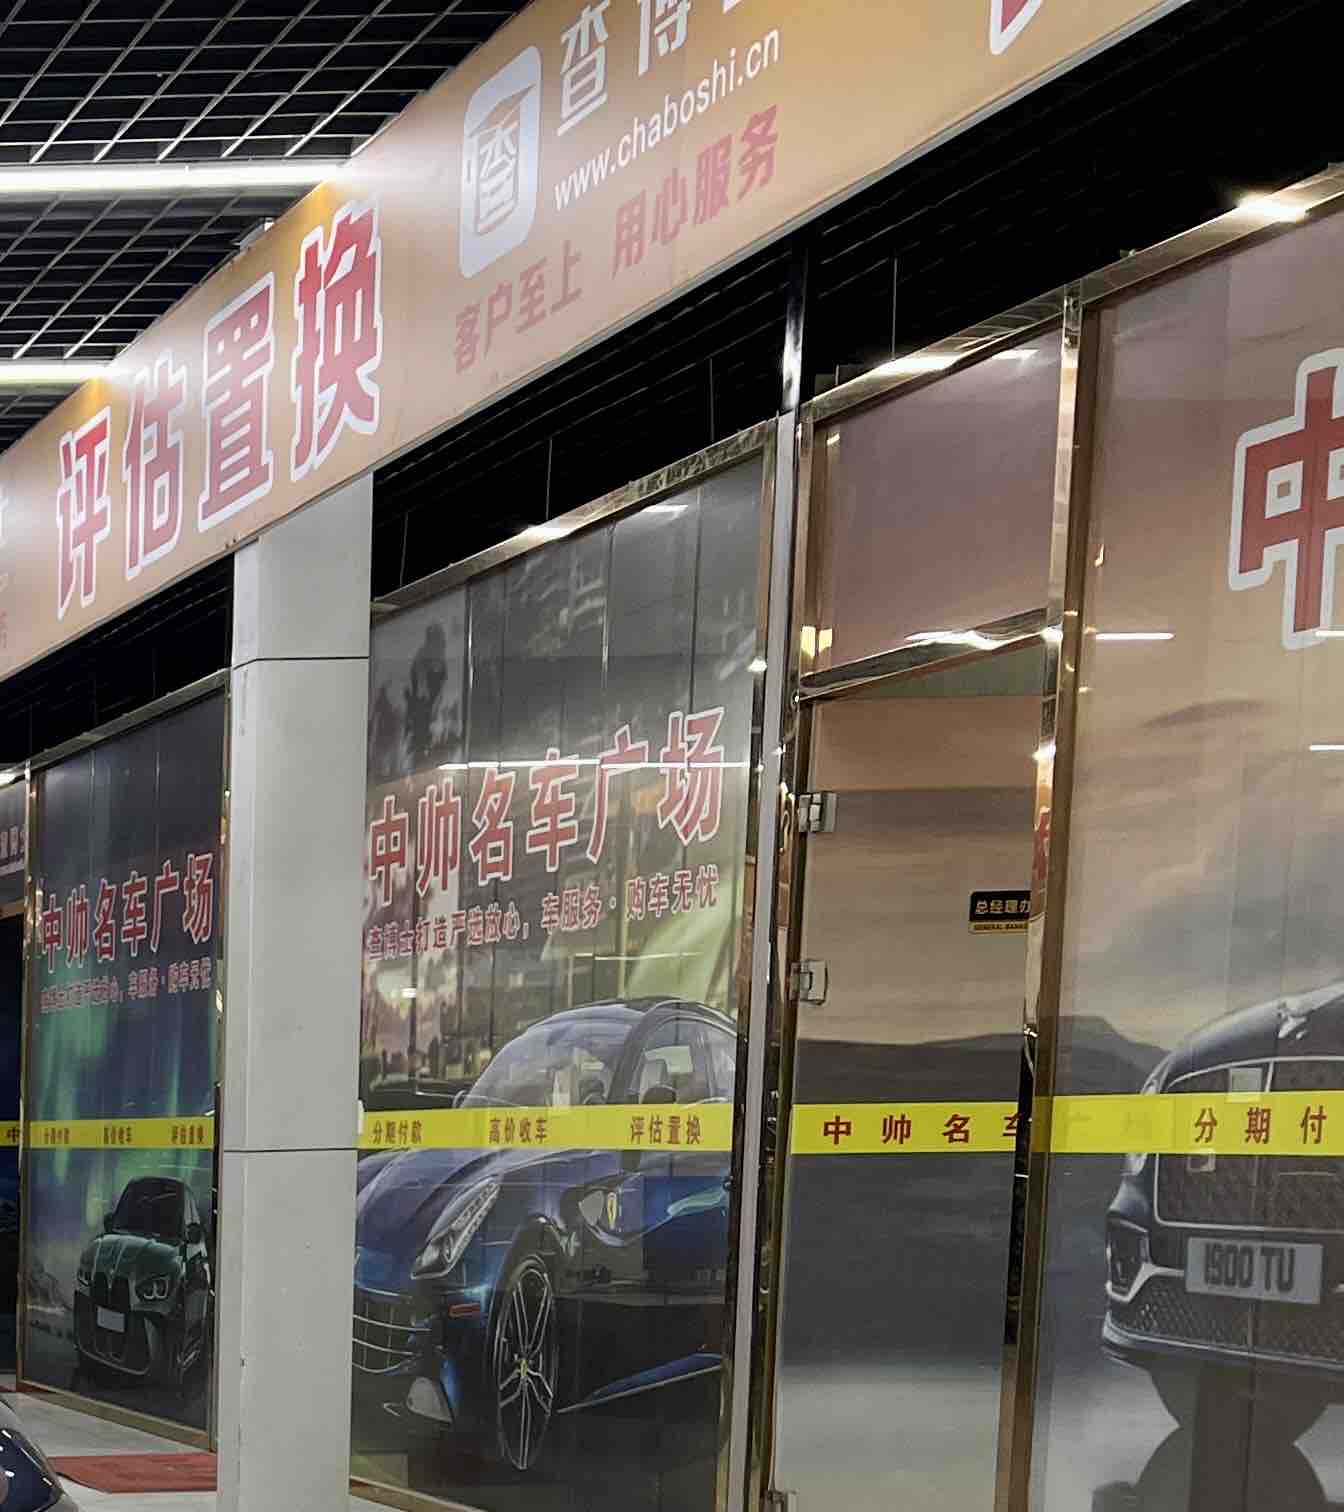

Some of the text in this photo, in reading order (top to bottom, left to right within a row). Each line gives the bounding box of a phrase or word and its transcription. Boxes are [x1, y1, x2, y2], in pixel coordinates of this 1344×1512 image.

[554, 29, 779, 211] www.chaboshi.cn
[456, 104, 779, 373] 客户至上 用心服务
[58, 199, 382, 619] 评估置换
[369, 706, 725, 908] 中帅名车广场
[40, 853, 213, 974] 中帅名车广场
[488, 1117, 549, 1145] 高价收车
[629, 1115, 703, 1146] 评估置换
[1193, 1105, 1328, 1146] 分期付
